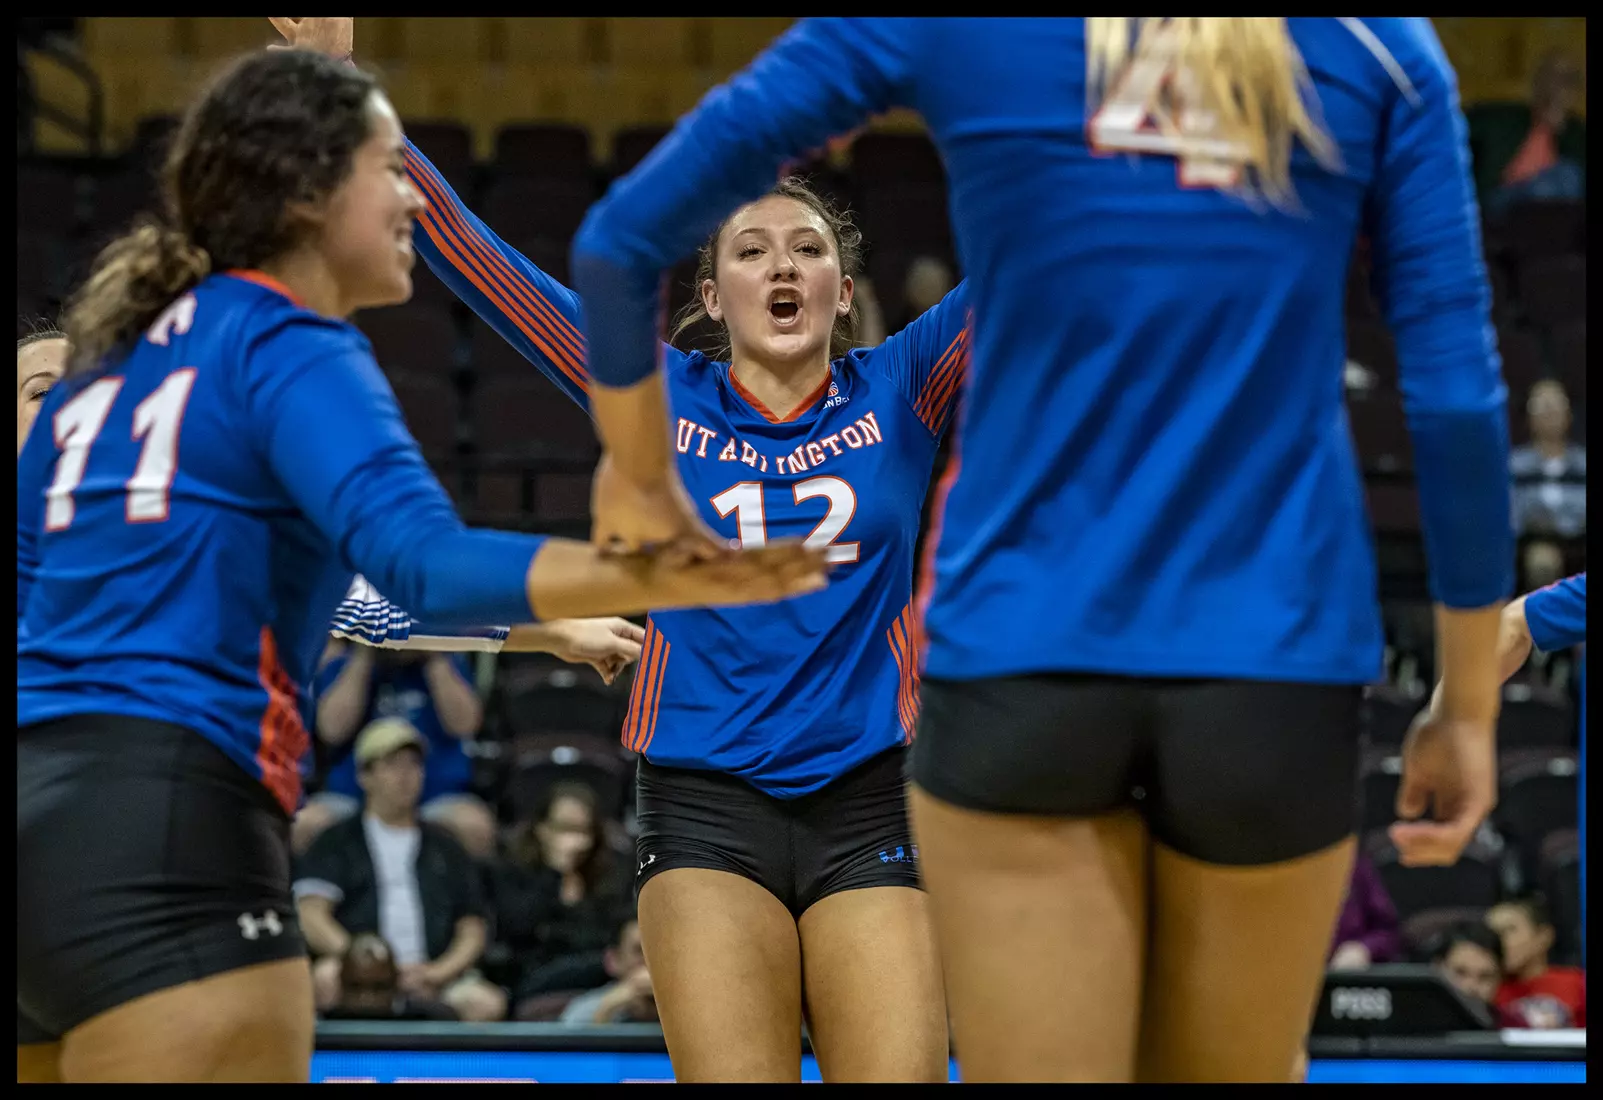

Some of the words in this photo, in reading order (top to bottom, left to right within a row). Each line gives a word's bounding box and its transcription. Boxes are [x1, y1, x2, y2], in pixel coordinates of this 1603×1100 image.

[1086, 22, 1256, 190] 4
[44, 366, 198, 533] 11
[675, 416, 718, 459] UT
[709, 474, 861, 565] 12
